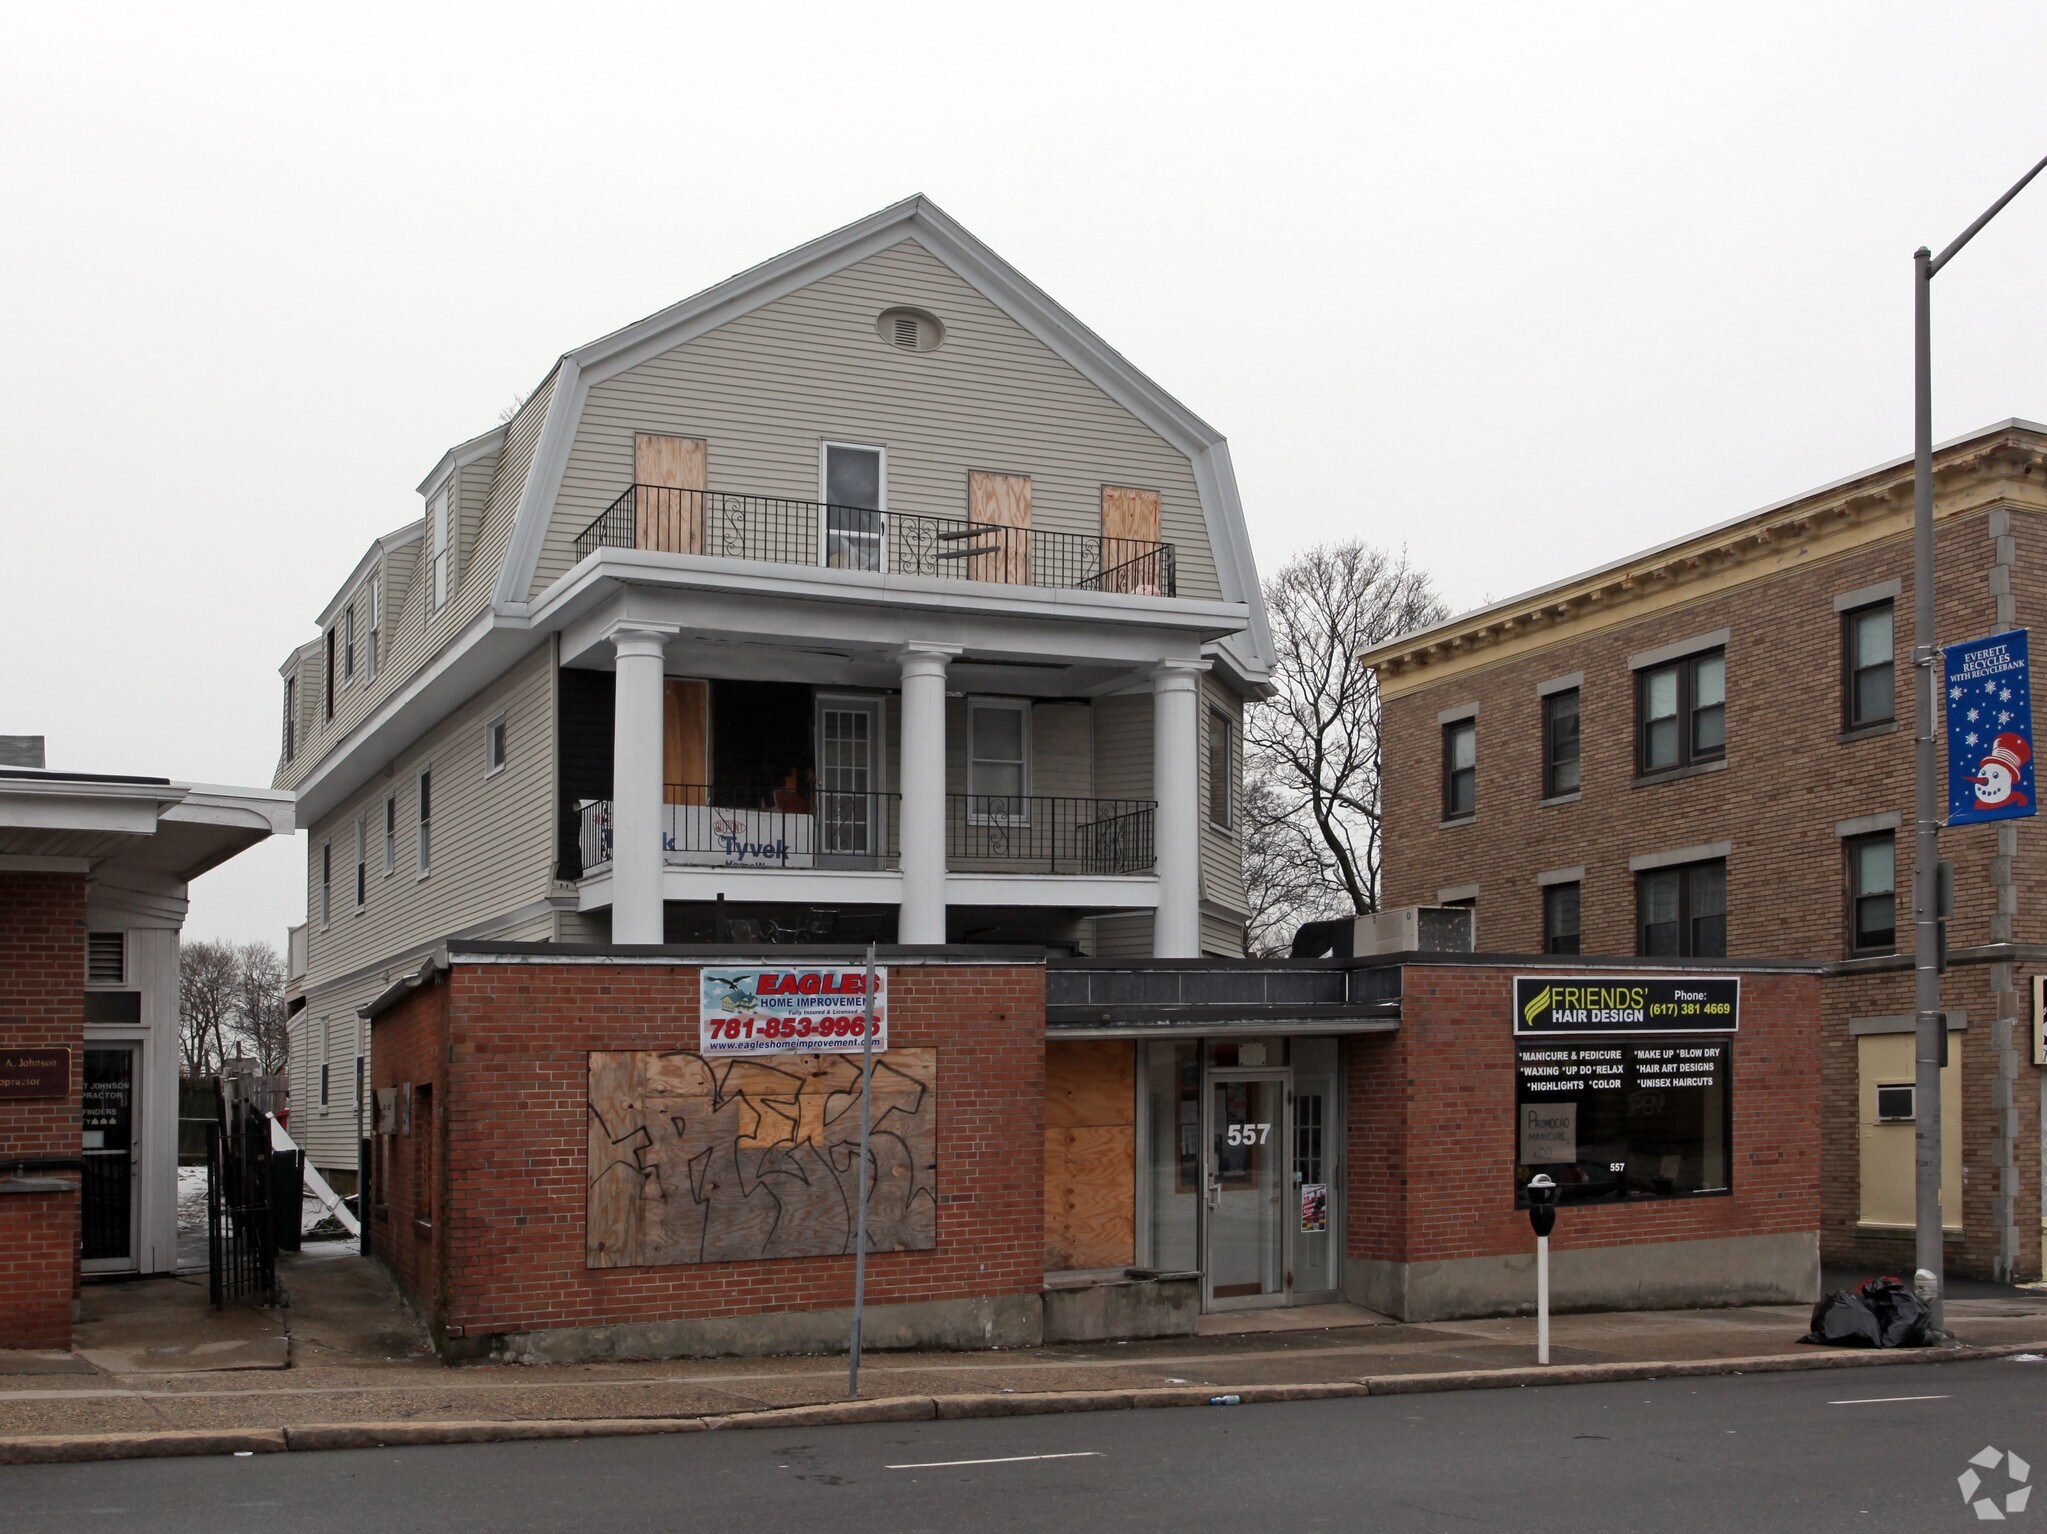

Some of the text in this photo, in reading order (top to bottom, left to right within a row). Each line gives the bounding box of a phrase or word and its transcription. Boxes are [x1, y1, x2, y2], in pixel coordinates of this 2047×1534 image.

[1964, 644, 2007, 663] EVERETT
[1963, 653, 2011, 673] RECYCLES
[1950, 659, 2025, 683] WITH RECYCLEBANK
[722, 835, 790, 861] Tyvek
[756, 973, 881, 995] EAGLES
[760, 998, 793, 1008] HOME
[1552, 986, 1707, 1009] FRIENDS' Phone:
[1552, 1009, 1644, 1023] HAIR DESIGN
[1650, 1002, 1730, 1018] (617) 381 4669
[709, 1015, 881, 1040] 781-853-9966
[709, 1038, 880, 1052] www.eagleshomeimprovement.cm
[1571, 1051, 1577, 1060] &
[1579, 1050, 1622, 1060] PEDICURE
[1663, 1049, 1674, 1059] UP
[1704, 1048, 1720, 1057] DRY
[5, 1058, 57, 1068] A. Johnson
[1579, 1065, 1592, 1075] DO
[1661, 1064, 1678, 1073] ART
[1679, 1062, 1714, 1072] DESIGNS
[90, 1082, 130, 1090] JOHNSON
[1673, 1077, 1713, 1087] HAIRCUTS
[1227, 1122, 1271, 1146] 557
[1609, 1162, 1625, 1172] 557
